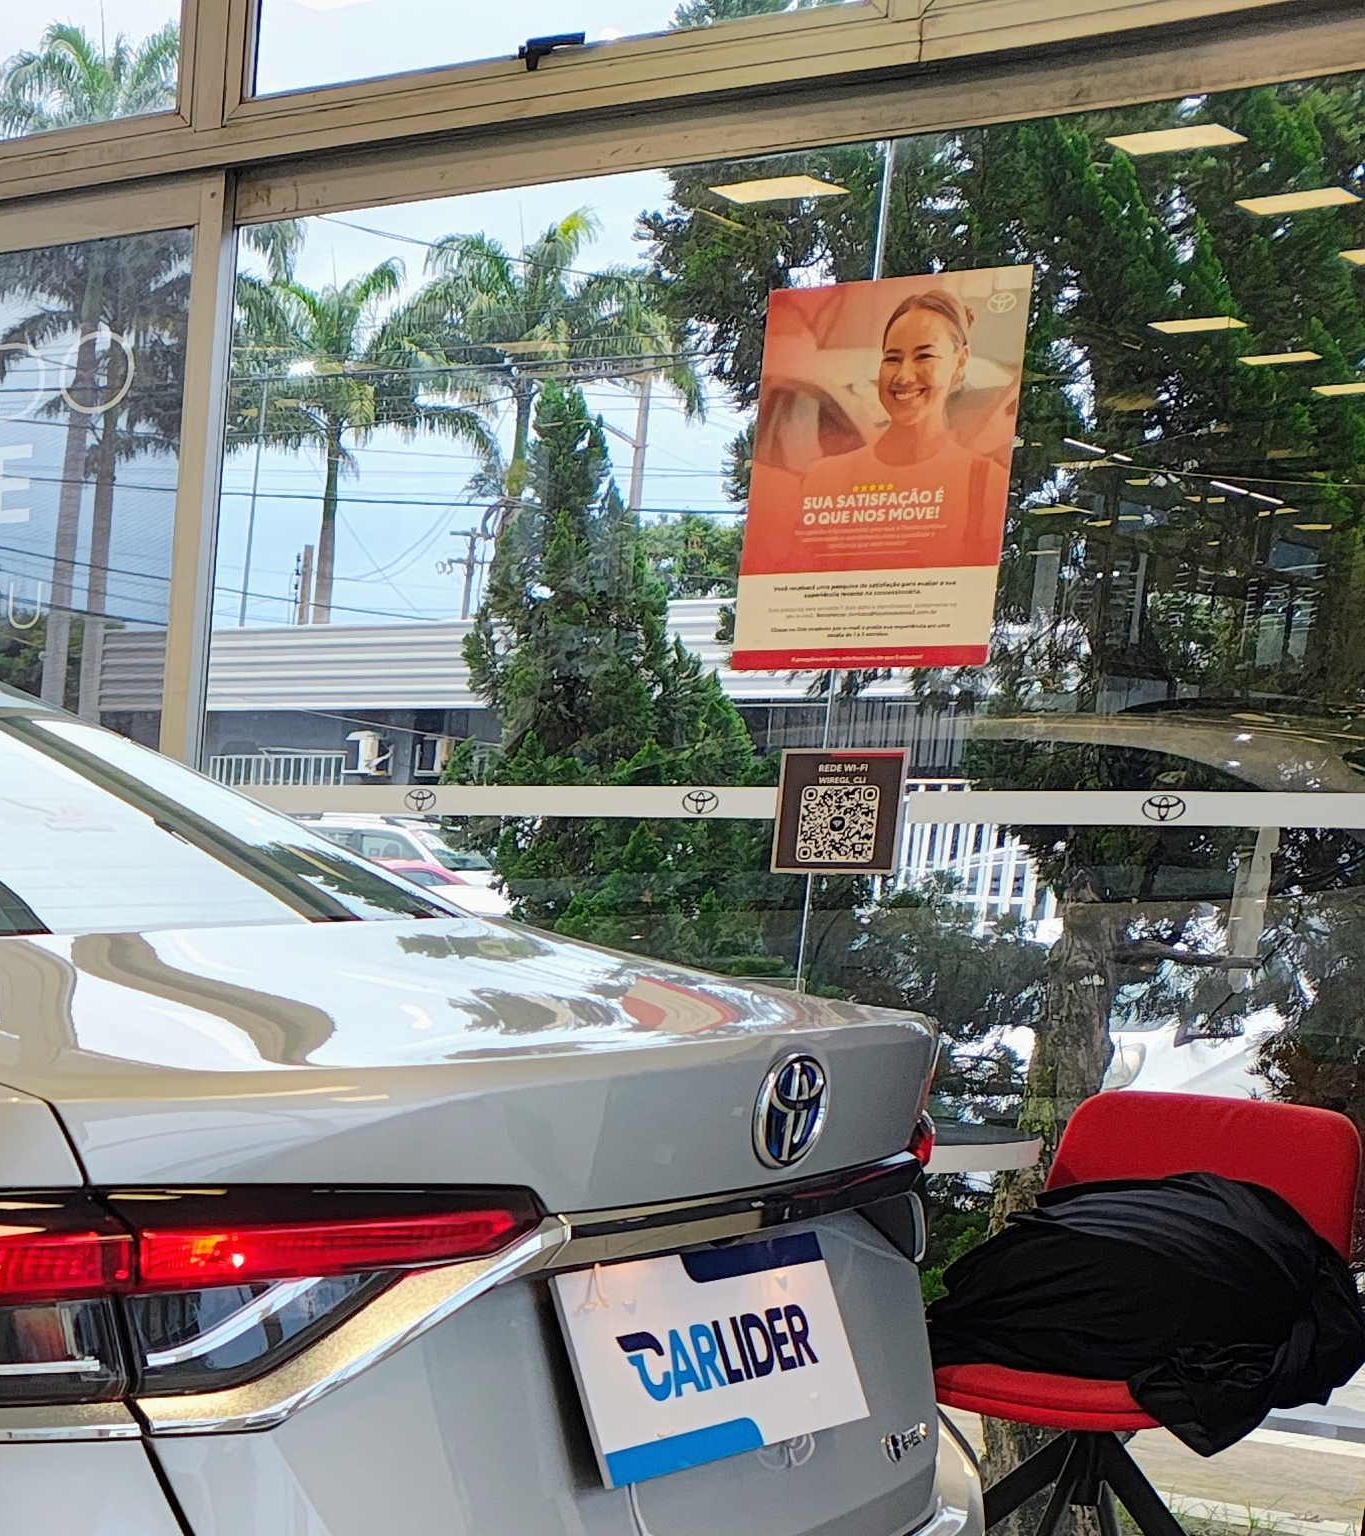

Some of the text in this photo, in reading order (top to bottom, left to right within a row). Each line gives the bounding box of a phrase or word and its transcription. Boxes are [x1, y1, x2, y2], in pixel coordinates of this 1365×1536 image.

[802, 485, 945, 510] SUA SATISFAÇÃO É
[802, 506, 940, 526] O QUE NOS MOVE!
[818, 763, 869, 773] REDE WI-FI
[615, 1303, 819, 1402] CARLIDER
